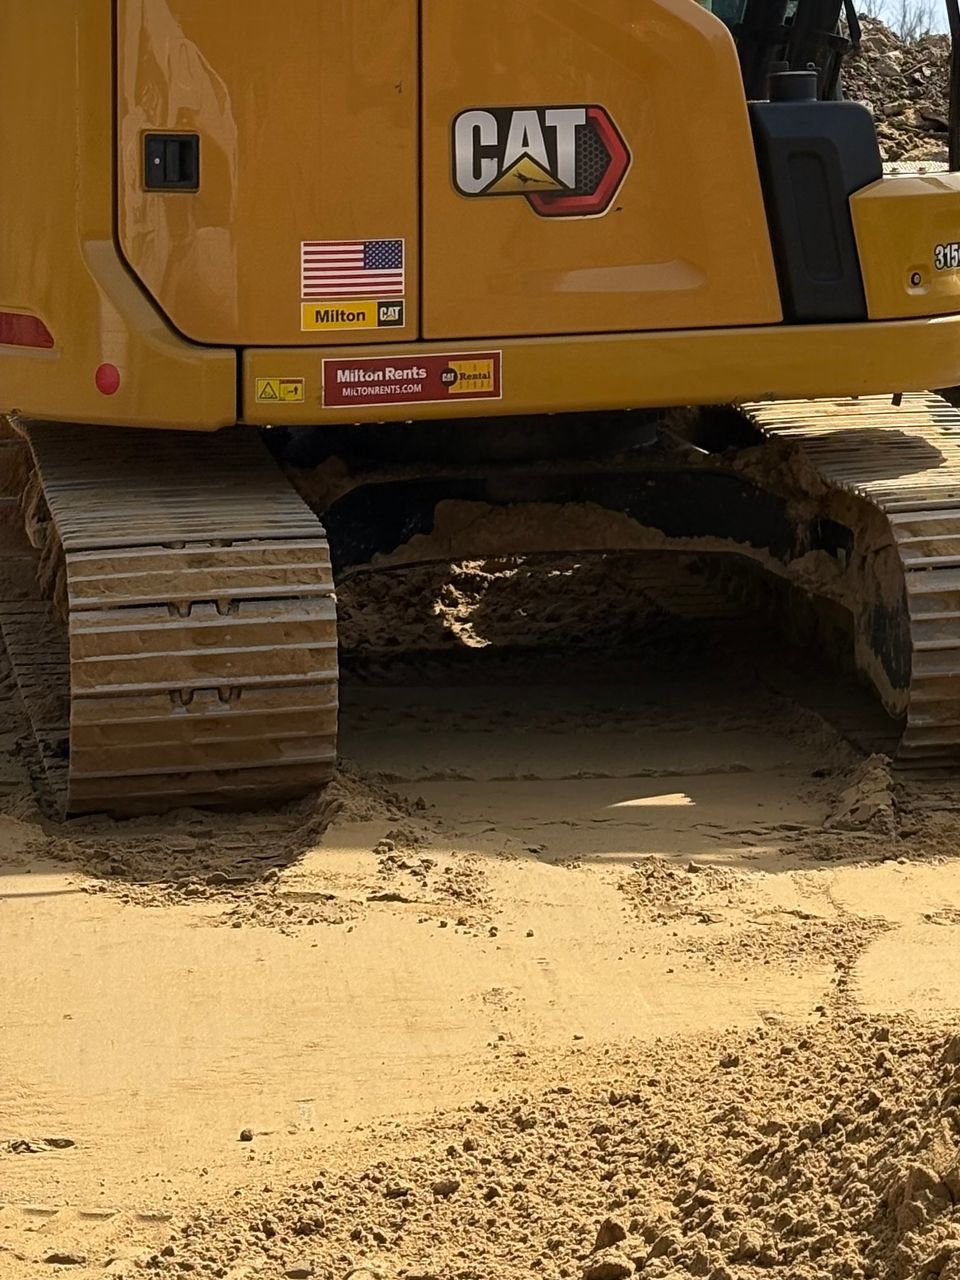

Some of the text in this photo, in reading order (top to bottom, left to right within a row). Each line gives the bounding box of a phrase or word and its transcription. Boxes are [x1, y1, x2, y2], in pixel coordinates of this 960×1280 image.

[455, 108, 587, 194] CAT
[935, 244, 958, 268] 315
[315, 306, 401, 323] Milton CAT
[336, 366, 427, 383] Milton Rents
[442, 370, 491, 382] CAT Rental
